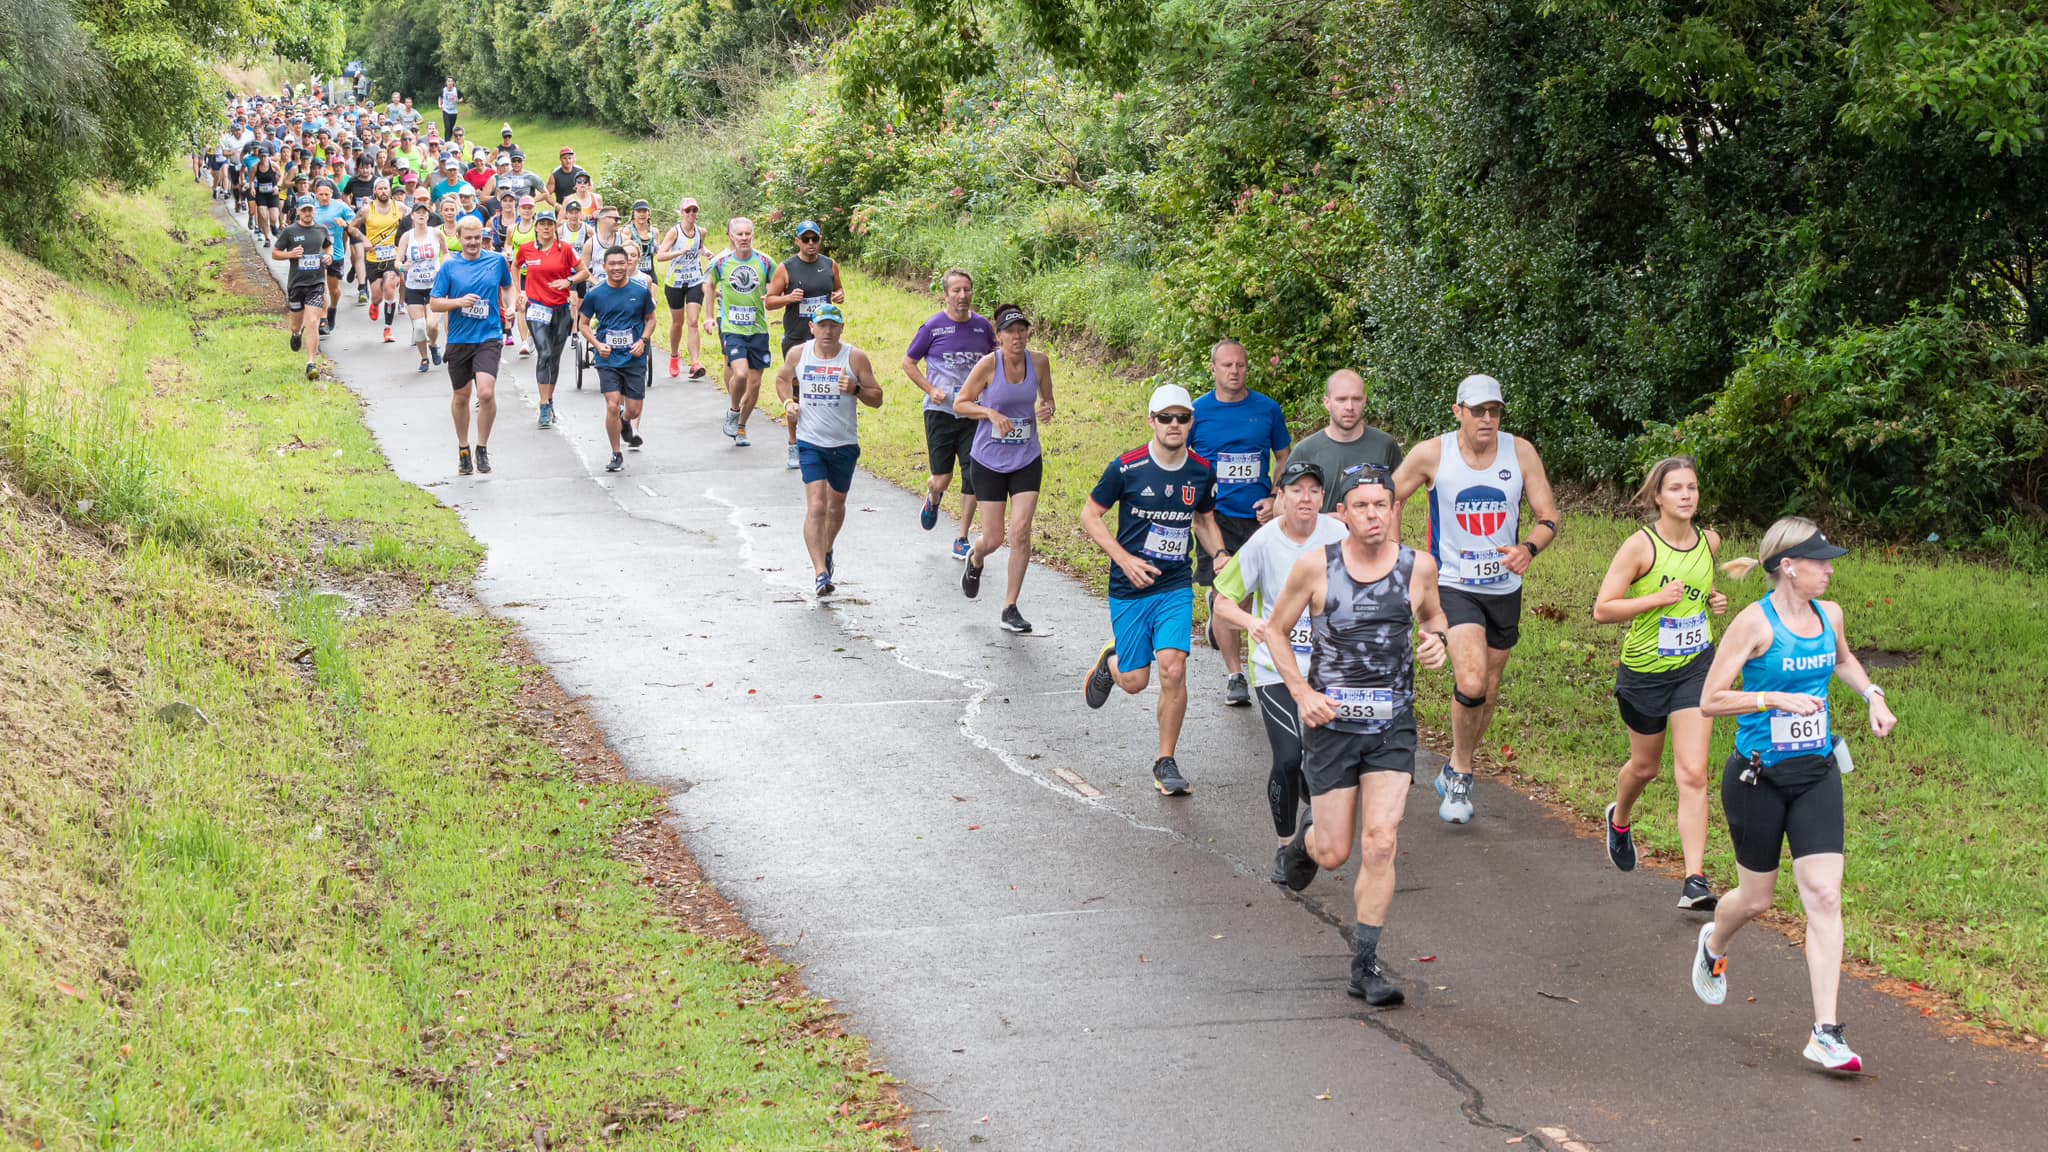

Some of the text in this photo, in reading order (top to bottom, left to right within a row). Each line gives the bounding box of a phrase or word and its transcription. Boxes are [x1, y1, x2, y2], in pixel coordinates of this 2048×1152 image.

[806, 304, 821, 313] 42
[612, 337, 628, 345] 699
[811, 383, 831, 394] 365
[1228, 465, 1252, 477] 215
[1158, 538, 1182, 553] 394
[1474, 560, 1500, 577] 159
[1675, 628, 1702, 647] 155
[1782, 651, 1837, 672] RUNFIT
[1340, 704, 1375, 718] 353
[1790, 718, 1821, 739] 661
